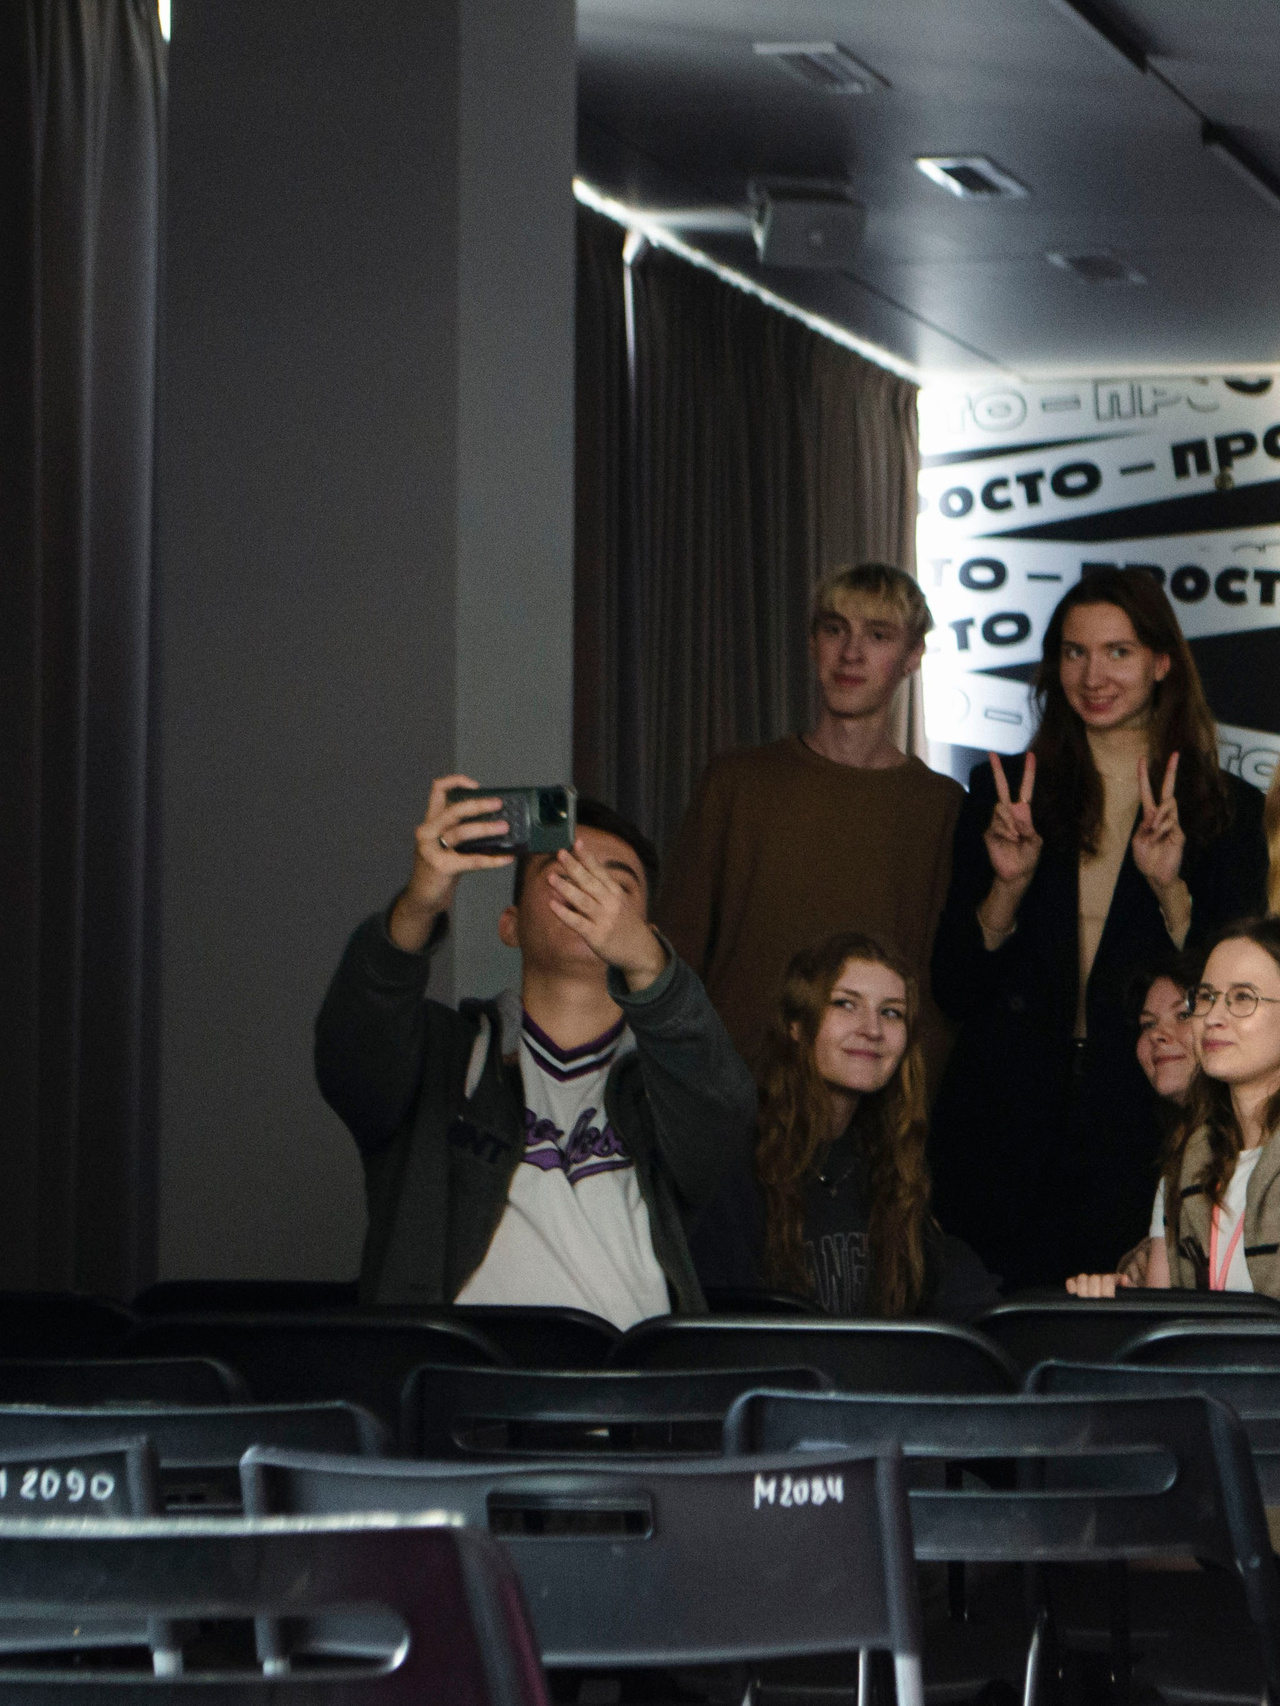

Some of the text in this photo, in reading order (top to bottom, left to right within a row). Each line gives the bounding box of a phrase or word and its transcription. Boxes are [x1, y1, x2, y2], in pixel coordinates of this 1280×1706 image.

[918, 461, 1102, 519] ОСТО
[930, 607, 1033, 654] ТО
[753, 1472, 844, 1510] M2084
